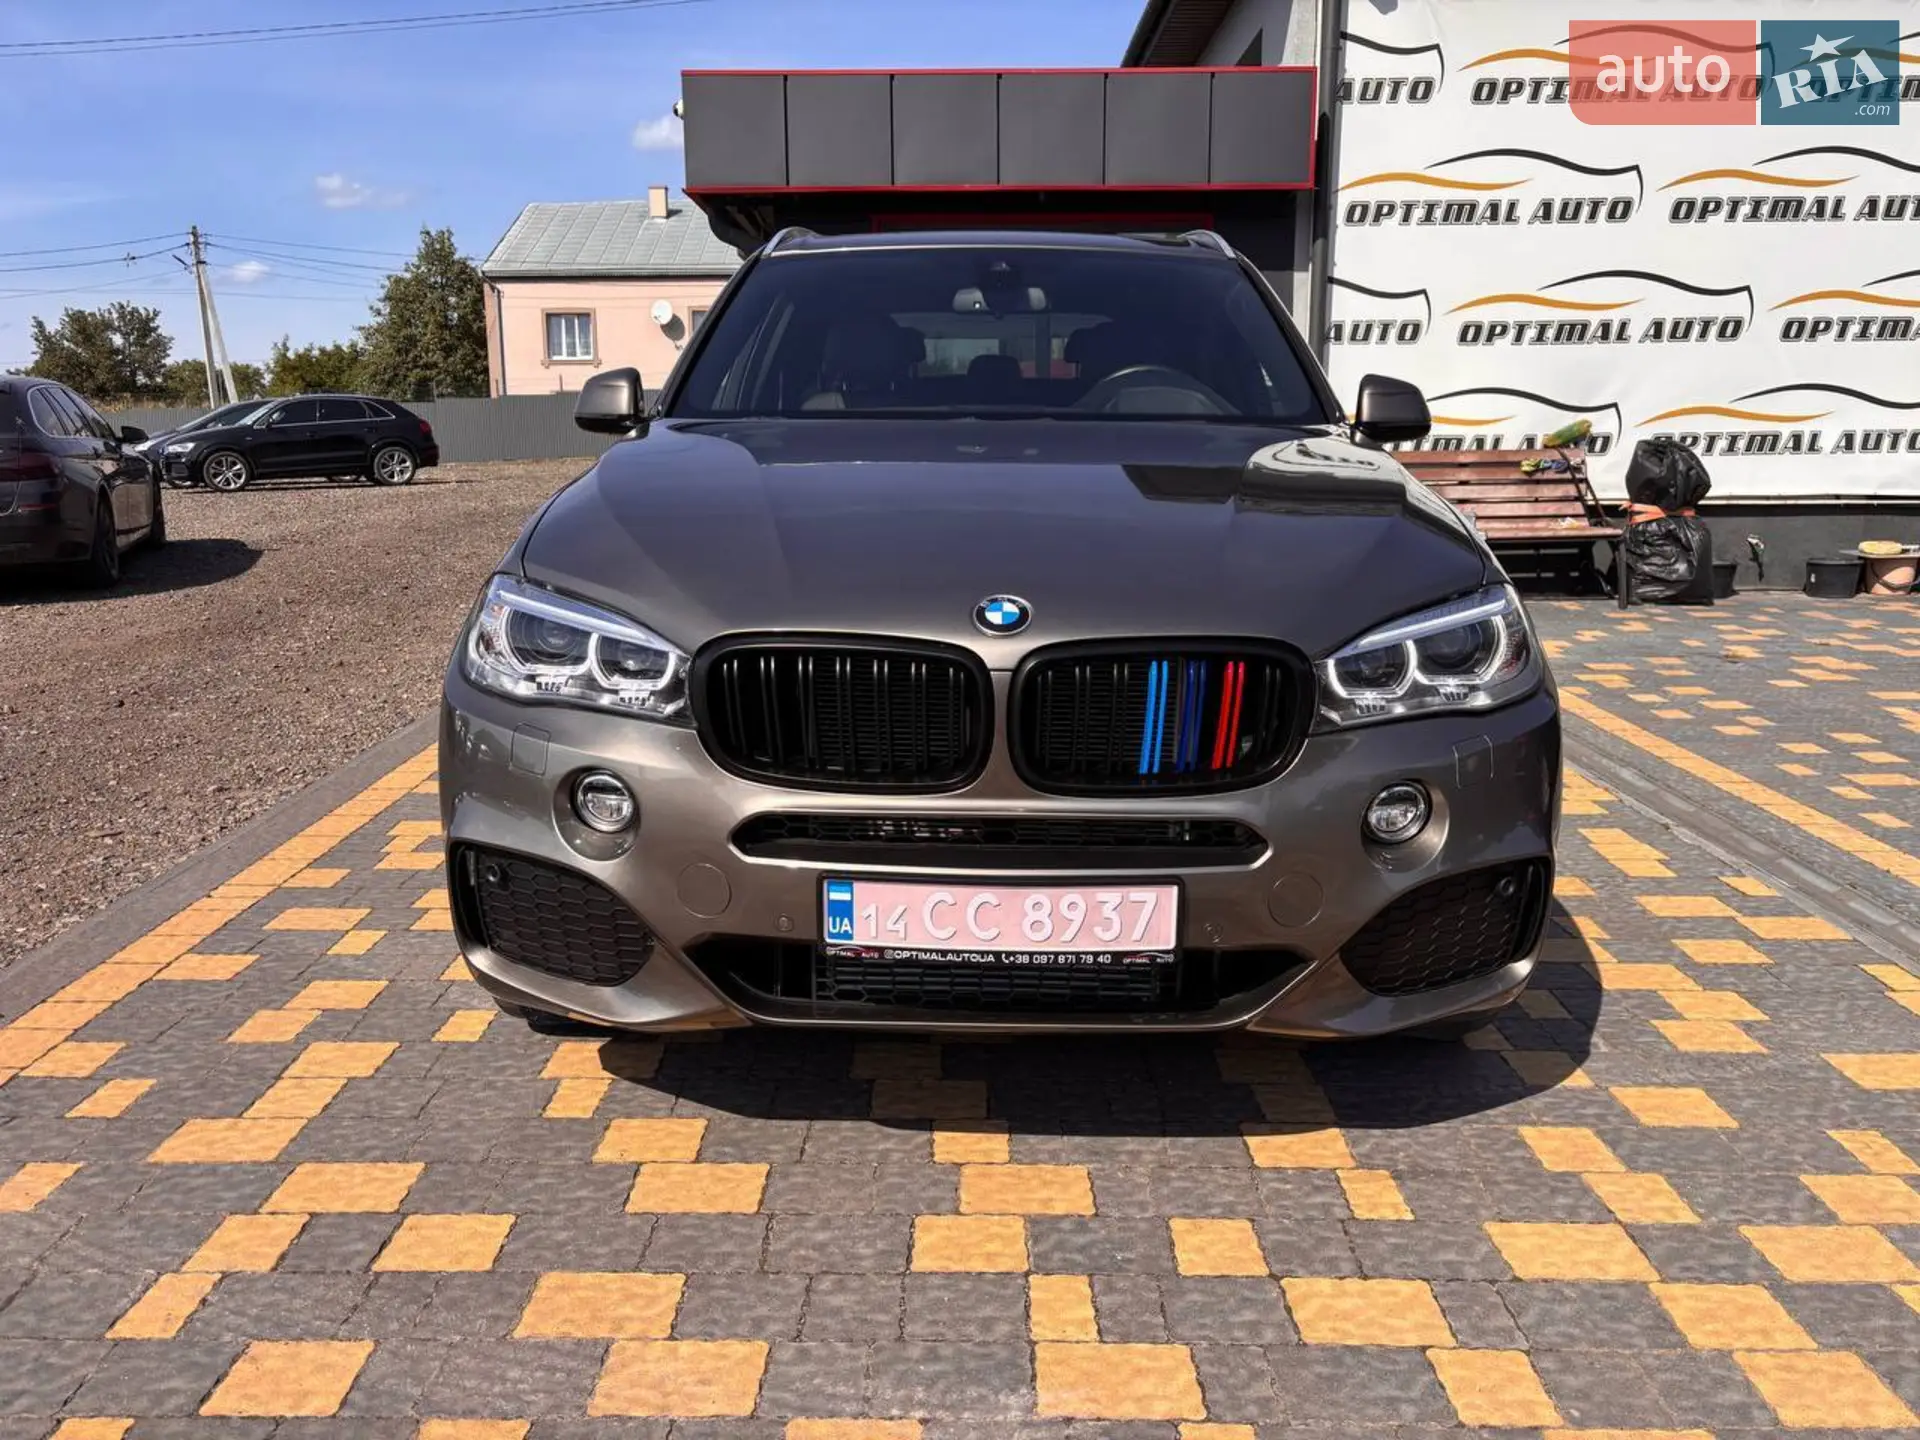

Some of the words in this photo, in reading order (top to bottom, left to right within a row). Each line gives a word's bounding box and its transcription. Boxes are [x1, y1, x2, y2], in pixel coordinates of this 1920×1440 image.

[1344, 200, 1520, 227] OPTIMAL
[1527, 196, 1636, 224] AUTO
[1669, 196, 1846, 223] OPTIMAL
[1325, 320, 1423, 345] AUTO
[1457, 319, 1632, 346] OPTIMAL
[1638, 316, 1745, 343] AUTO
[829, 916, 852, 934] UA
[862, 903, 908, 940] 14
[922, 891, 1001, 941] CC
[1021, 891, 1158, 943] 8937
